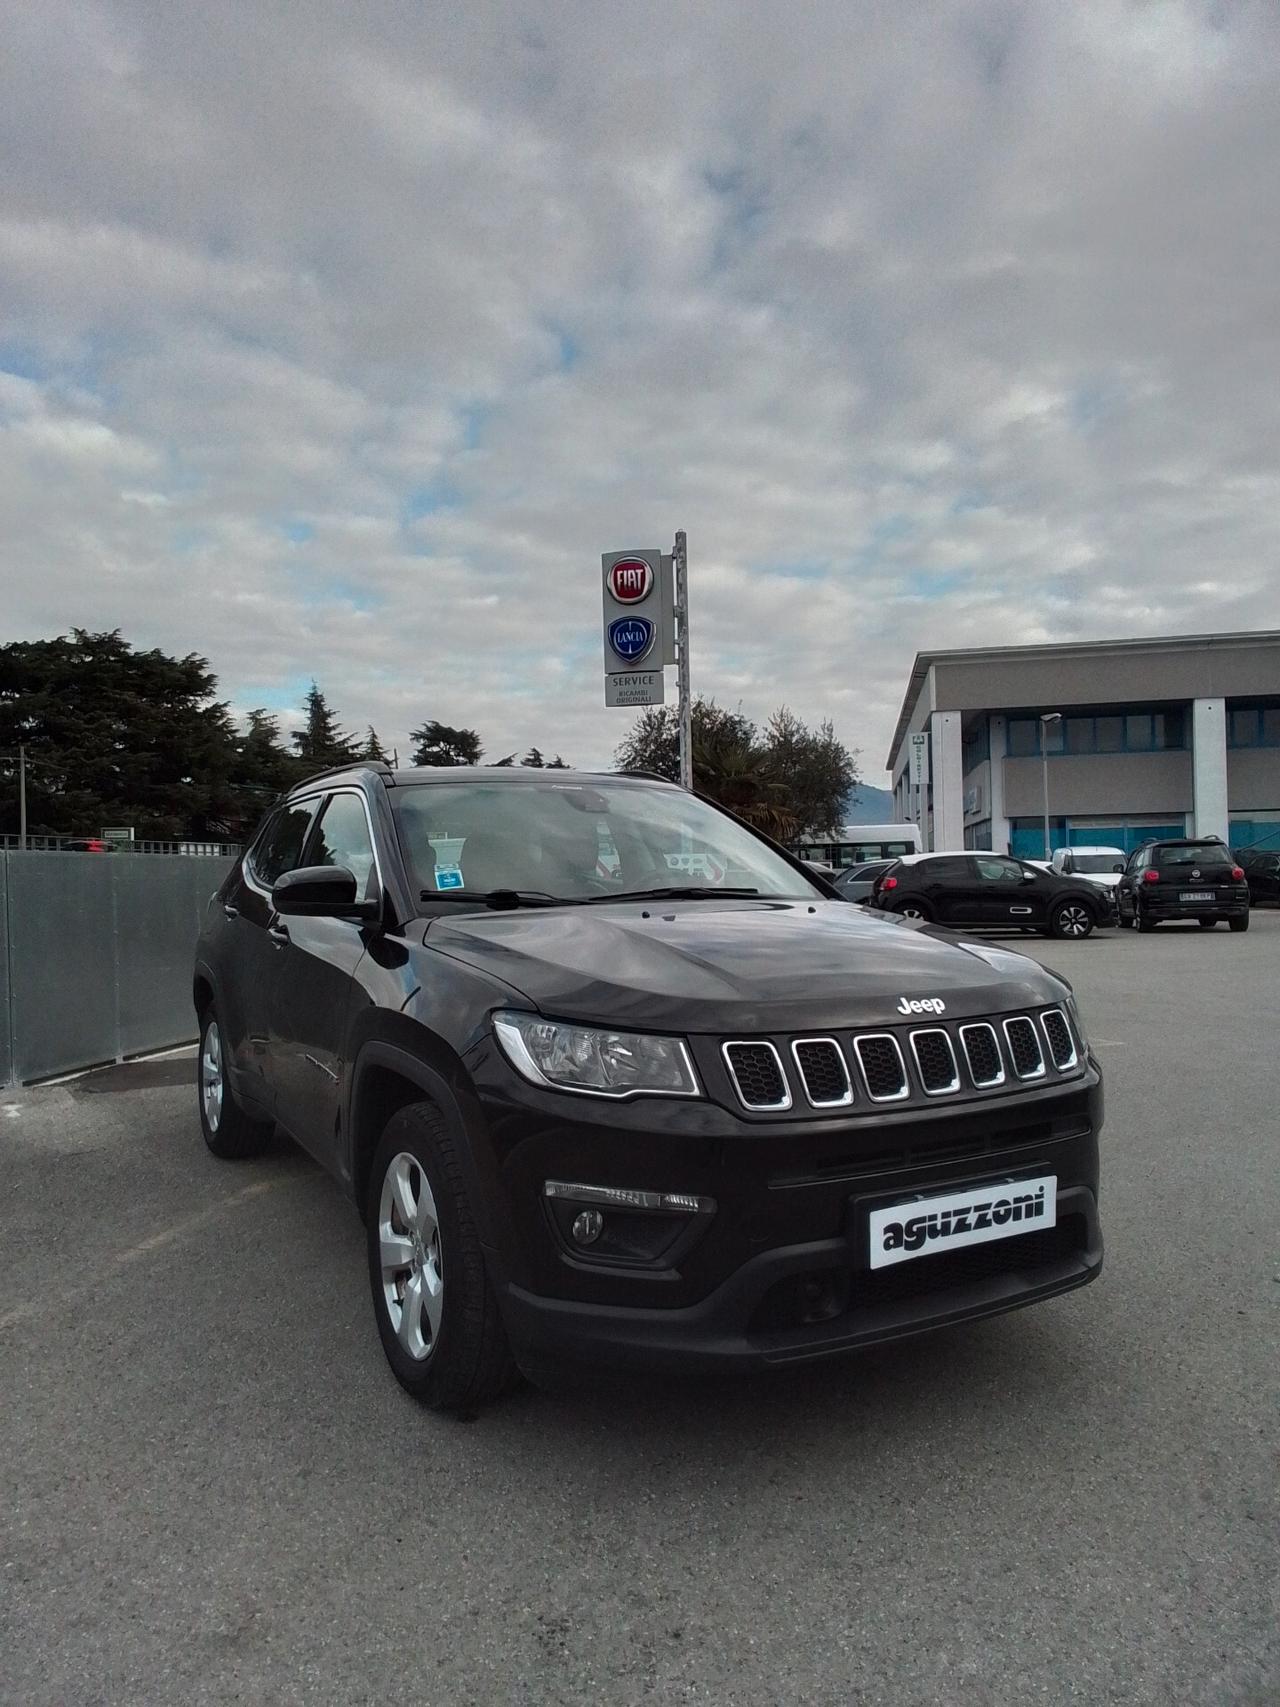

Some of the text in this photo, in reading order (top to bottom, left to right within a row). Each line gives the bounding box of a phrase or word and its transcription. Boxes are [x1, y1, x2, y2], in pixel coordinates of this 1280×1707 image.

[617, 569, 643, 590] FIAT
[618, 631, 643, 643] LANCIA
[613, 675, 654, 686] SERVICE
[616, 696, 652, 704] ORIGINALI
[897, 997, 945, 1015] Jeep
[883, 1186, 1044, 1251] aguzzoni
